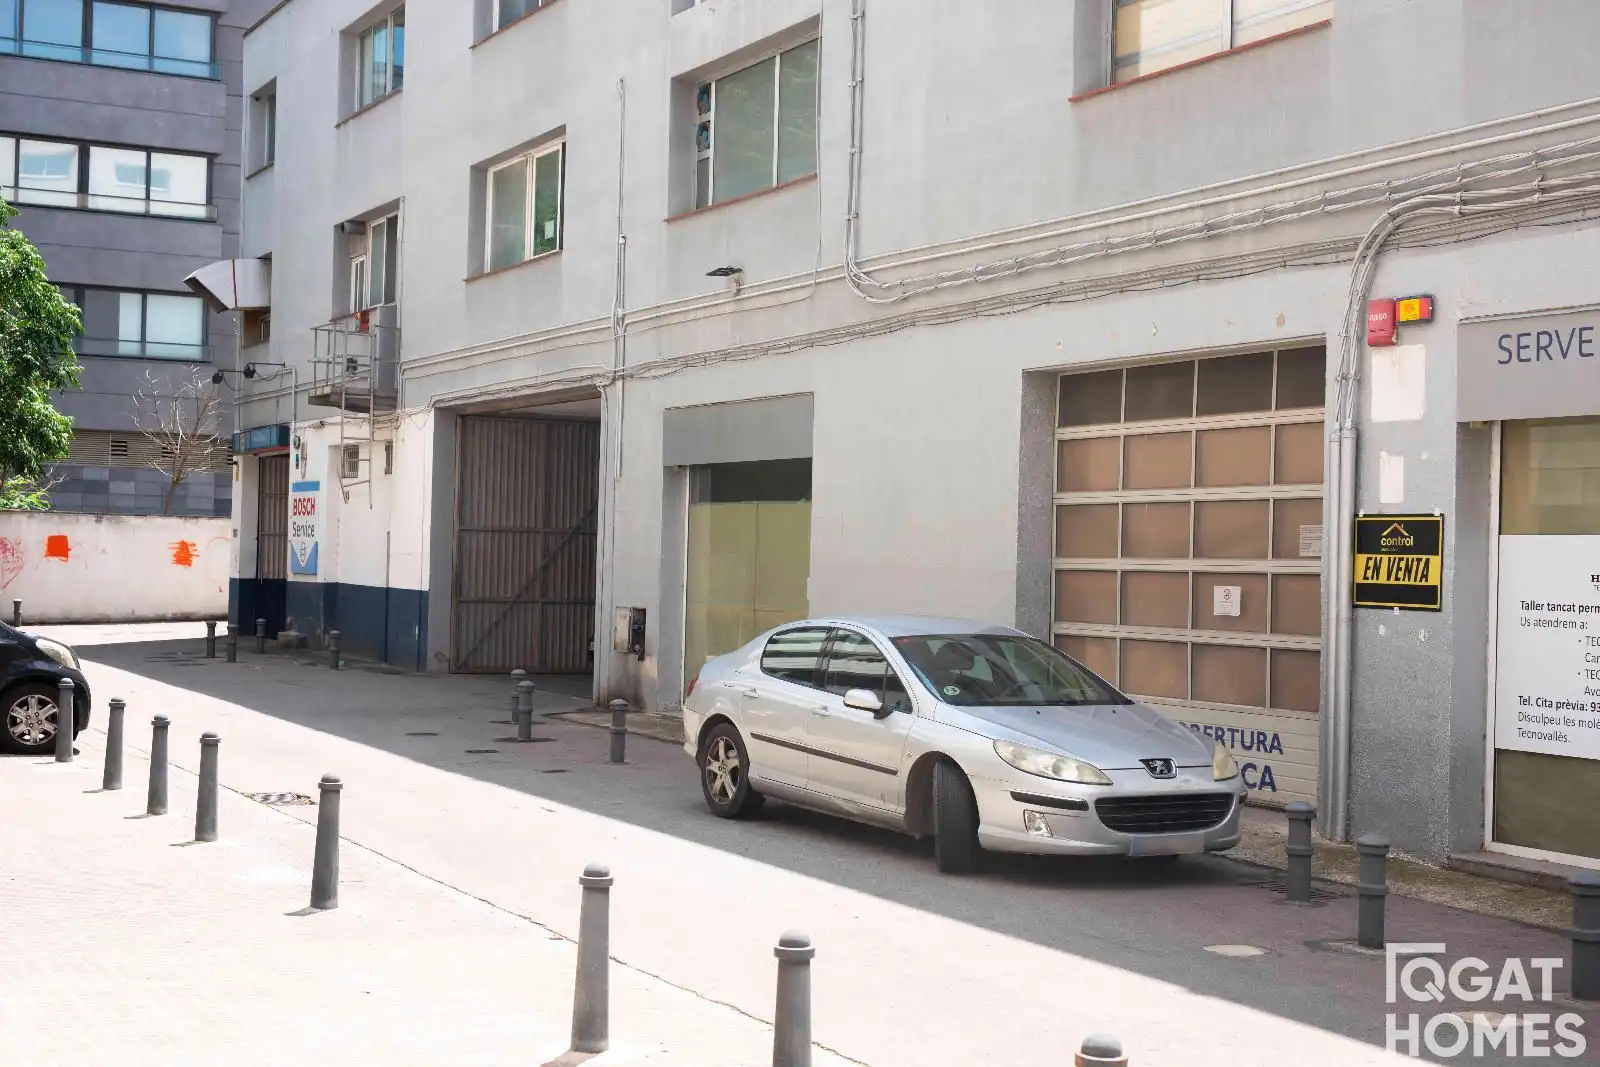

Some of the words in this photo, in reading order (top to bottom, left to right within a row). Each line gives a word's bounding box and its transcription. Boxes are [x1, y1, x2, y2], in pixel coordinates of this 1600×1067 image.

[1497, 326, 1595, 365] SERVE
[293, 497, 316, 516] BOSCH
[292, 520, 315, 538] Service
[1380, 535, 1414, 547] control
[1362, 556, 1383, 581] EN
[1386, 556, 1431, 583] VENTA
[1520, 600, 1544, 611] Taller
[1547, 602, 1576, 612] tancat
[1520, 616, 1531, 627] Us
[1533, 617, 1577, 629] atendrem
[1579, 621, 1588, 630] a:
[1517, 695, 1533, 707] Tel.
[1535, 697, 1553, 709] Cita
[1555, 698, 1588, 712] prèvia:
[1517, 711, 1561, 727] Disculpeu
[1563, 715, 1576, 727] les
